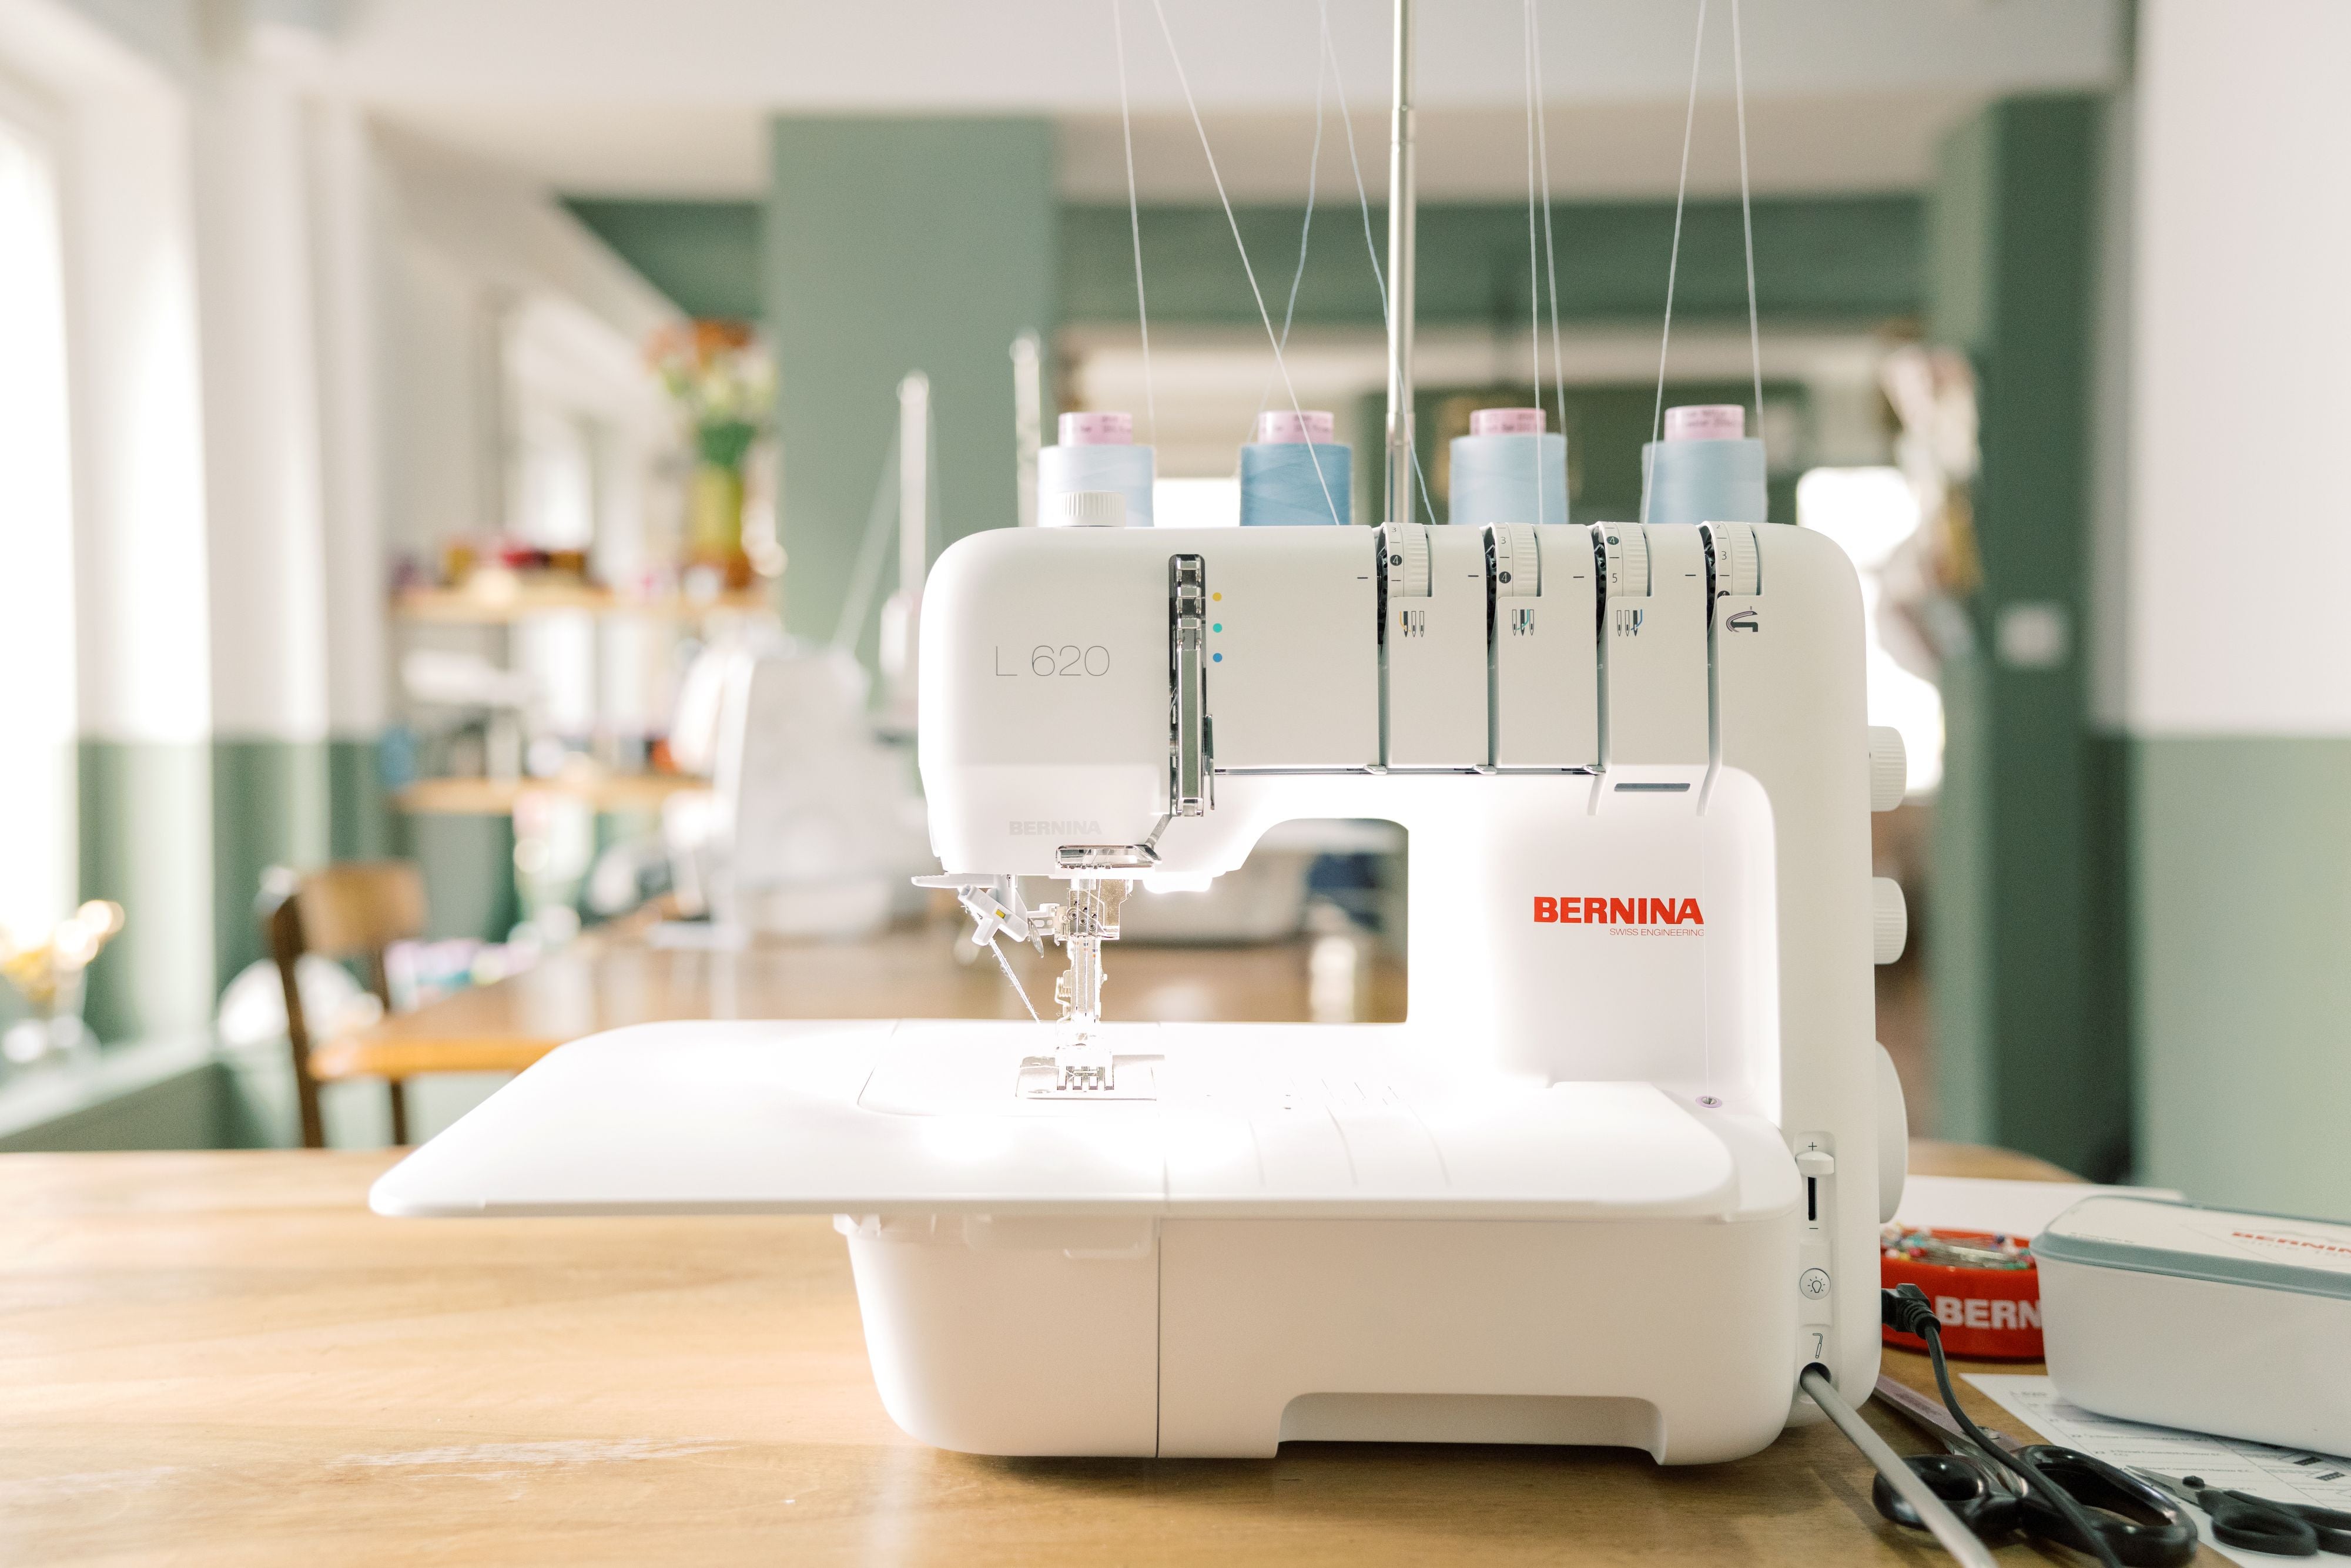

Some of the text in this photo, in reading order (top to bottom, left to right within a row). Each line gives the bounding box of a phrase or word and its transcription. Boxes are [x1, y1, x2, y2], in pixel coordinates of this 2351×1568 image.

[1500, 536, 1506, 544] 3
[1720, 551, 1727, 560] 3
[1612, 573, 1617, 583] 5
[996, 645, 1110, 676] L 620
[1009, 820, 1102, 835] BERNINA
[1533, 896, 1704, 924] BERNINA
[1609, 928, 1704, 936] SWISS ENGINEERING
[1934, 1295, 2042, 1330] BERN
